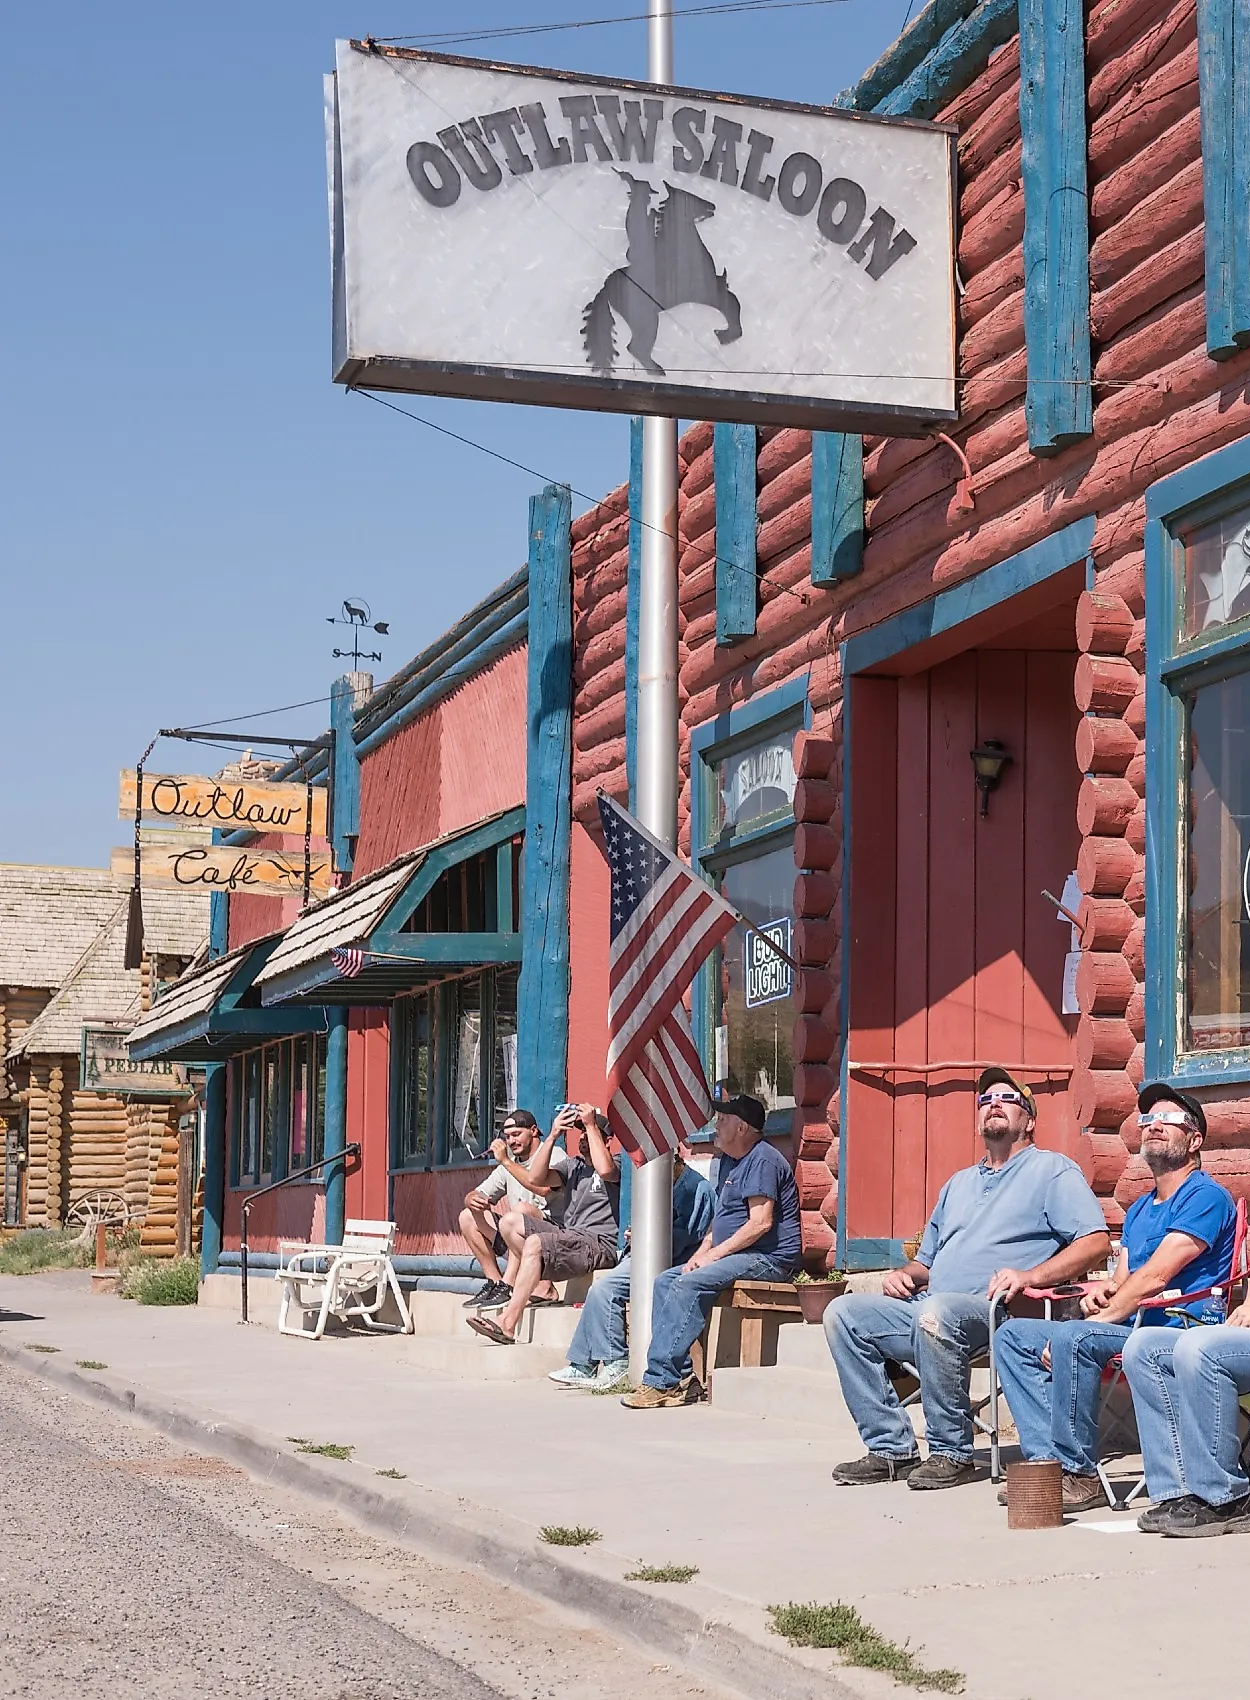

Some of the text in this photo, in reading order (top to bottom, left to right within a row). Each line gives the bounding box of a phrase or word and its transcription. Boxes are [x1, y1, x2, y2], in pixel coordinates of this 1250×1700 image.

[406, 95, 918, 281] OUTLAW SALOON
[332, 648, 382, 663] S N
[151, 778, 302, 825] Outlaw
[167, 849, 260, 890] Café
[753, 927, 783, 967] BUD
[748, 959, 788, 998] LIGHT
[104, 1058, 173, 1075] PEDLAR
